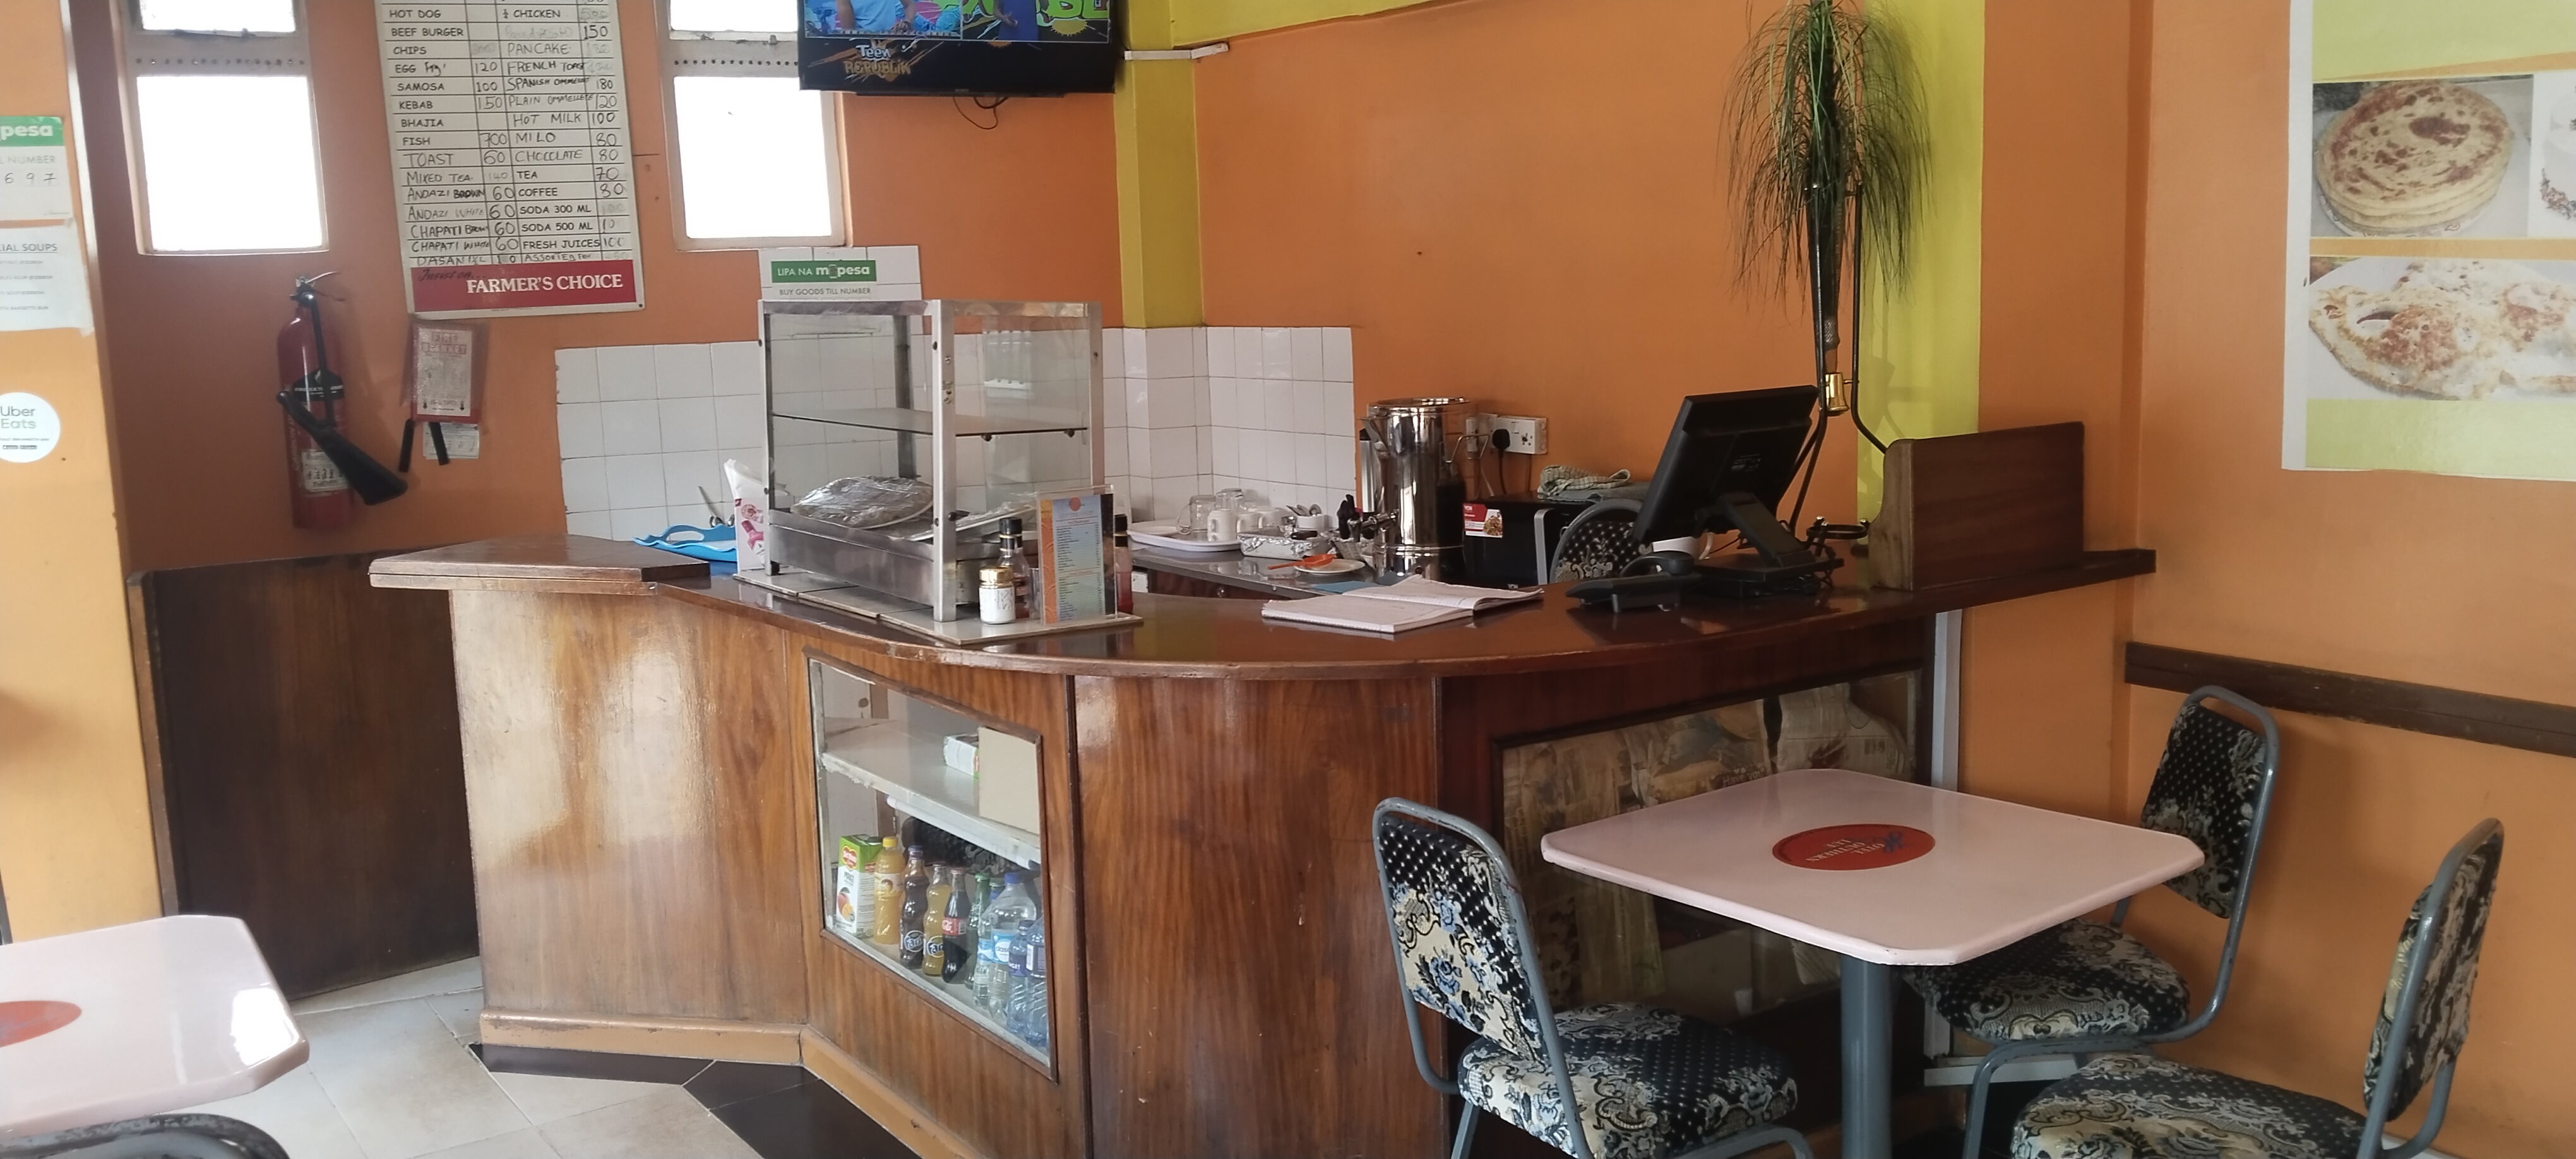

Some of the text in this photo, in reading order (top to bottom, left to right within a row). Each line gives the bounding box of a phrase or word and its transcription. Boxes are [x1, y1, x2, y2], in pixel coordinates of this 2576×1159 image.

[389, 9, 441, 18] HOT DOG
[513, 9, 561, 18] CHICKEN
[391, 28, 463, 37] BEEF BURGER
[584, 25, 608, 40] 150
[393, 46, 427, 55] CHIPS
[508, 43, 570, 56] PANCAKE
[856, 45, 891, 58] Teen
[395, 64, 417, 73] EGG
[475, 62, 498, 74] 120
[507, 61, 556, 75] FRENCH
[844, 60, 910, 74] REPUBLIK
[397, 81, 498, 92] SAMOSA 100
[506, 78, 550, 91] SPANISH
[596, 78, 613, 90] 180
[399, 96, 503, 110] KEBAB 150
[508, 95, 540, 107] PLAIN
[595, 95, 617, 110] 120
[401, 119, 444, 127] BHAJIA
[513, 112, 615, 127] HOT MILK 100
[403, 133, 508, 148] FISH 700
[516, 132, 617, 146] MILO 80
[8, 155, 56, 164] NUMBER
[403, 150, 505, 167] TOAST 60
[599, 149, 619, 162] 80
[407, 171, 442, 186] MIXED
[516, 167, 619, 181] TEA 70
[492, 186, 515, 201] 60
[518, 183, 624, 198] COFFEE 80
[489, 205, 516, 220] 60
[520, 206, 550, 215] SODA
[554, 205, 573, 213] 300
[576, 205, 592, 213] ML
[411, 225, 462, 239] CHAPATI
[494, 222, 516, 236] 60
[522, 223, 551, 232] SODA
[556, 222, 575, 231] 500
[578, 222, 593, 230] ML
[411, 241, 459, 253] CHAPATI
[495, 237, 519, 251] 60
[523, 241, 558, 250] FRESH
[561, 239, 600, 249] JUICES
[777, 268, 796, 276] LIPA
[798, 268, 813, 276] NA
[466, 274, 624, 294] FARMER'S CHOICE
[0, 405, 36, 417] Uber
[1, 418, 37, 429] Eats
